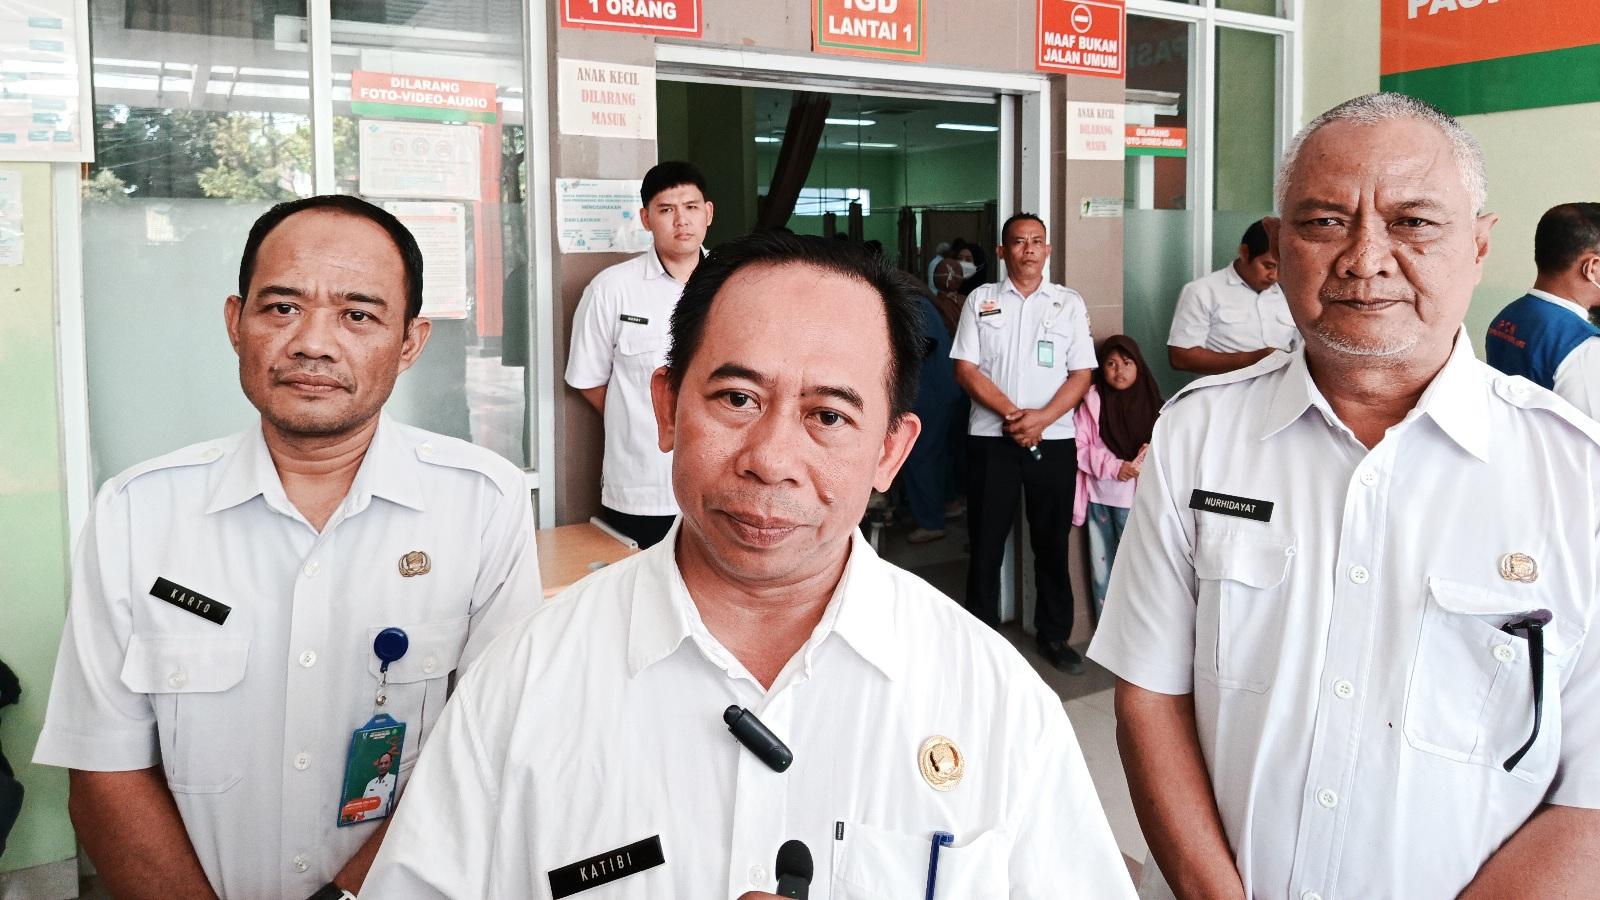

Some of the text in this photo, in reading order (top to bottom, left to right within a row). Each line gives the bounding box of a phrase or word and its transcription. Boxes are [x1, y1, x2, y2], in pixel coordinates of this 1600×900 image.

[589, 0, 677, 20] 1 ORANG
[828, 15, 912, 42] LANTAI 1
[1044, 32, 1117, 53] MAAF BUKAN
[1044, 48, 1117, 68] JALAN UMUM
[390, 77, 460, 94] DILARANG
[577, 67, 640, 86] ANAK KECIL
[360, 87, 488, 109] FOTO-VIDEO-AUDIO
[581, 89, 636, 106] DILARANG
[591, 111, 627, 127] MASUK
[1124, 136, 1184, 147] OTO-VIDEO-AUDIO
[1204, 497, 1257, 514] NURHIDAYAT
[170, 588, 211, 613] KARTO
[580, 852, 632, 882] KATIBI
